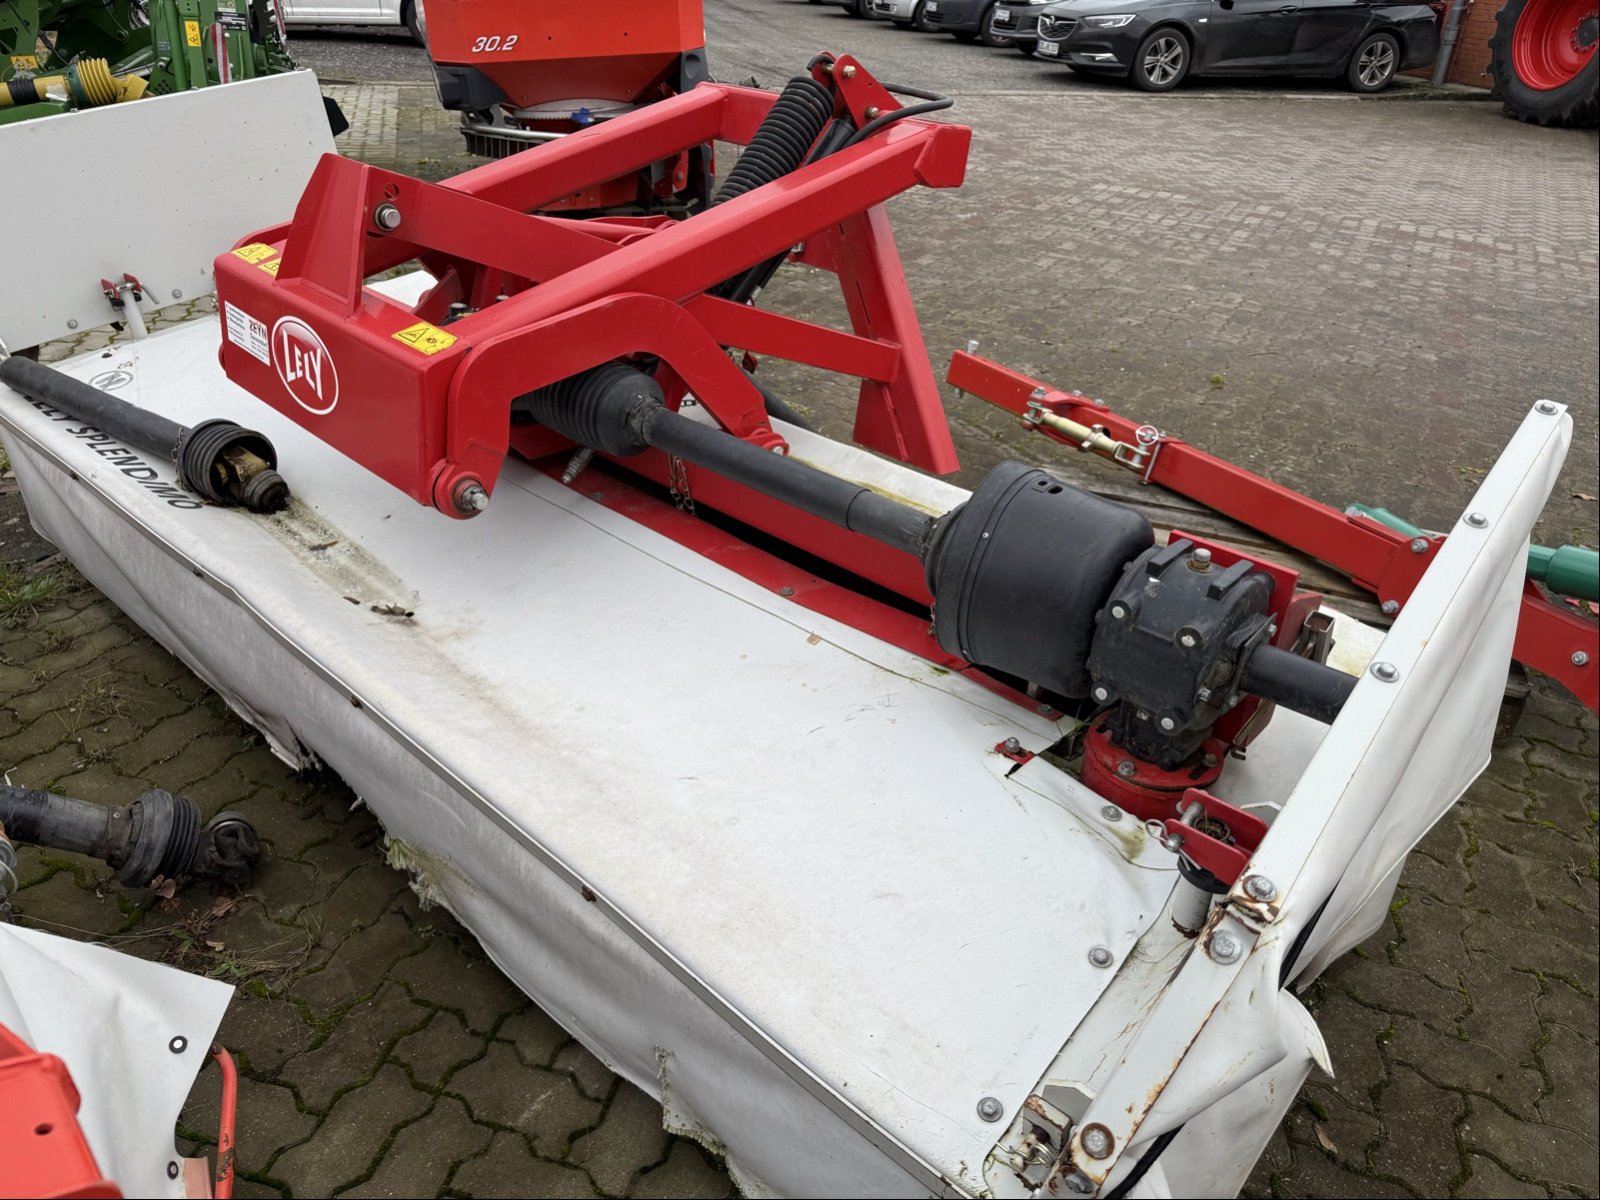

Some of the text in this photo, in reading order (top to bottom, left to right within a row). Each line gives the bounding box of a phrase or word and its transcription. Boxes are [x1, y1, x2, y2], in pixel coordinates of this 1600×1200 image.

[471, 34, 518, 53] 30.2
[282, 327, 323, 401] LELY
[65, 426, 203, 509] SPLENDIMO
